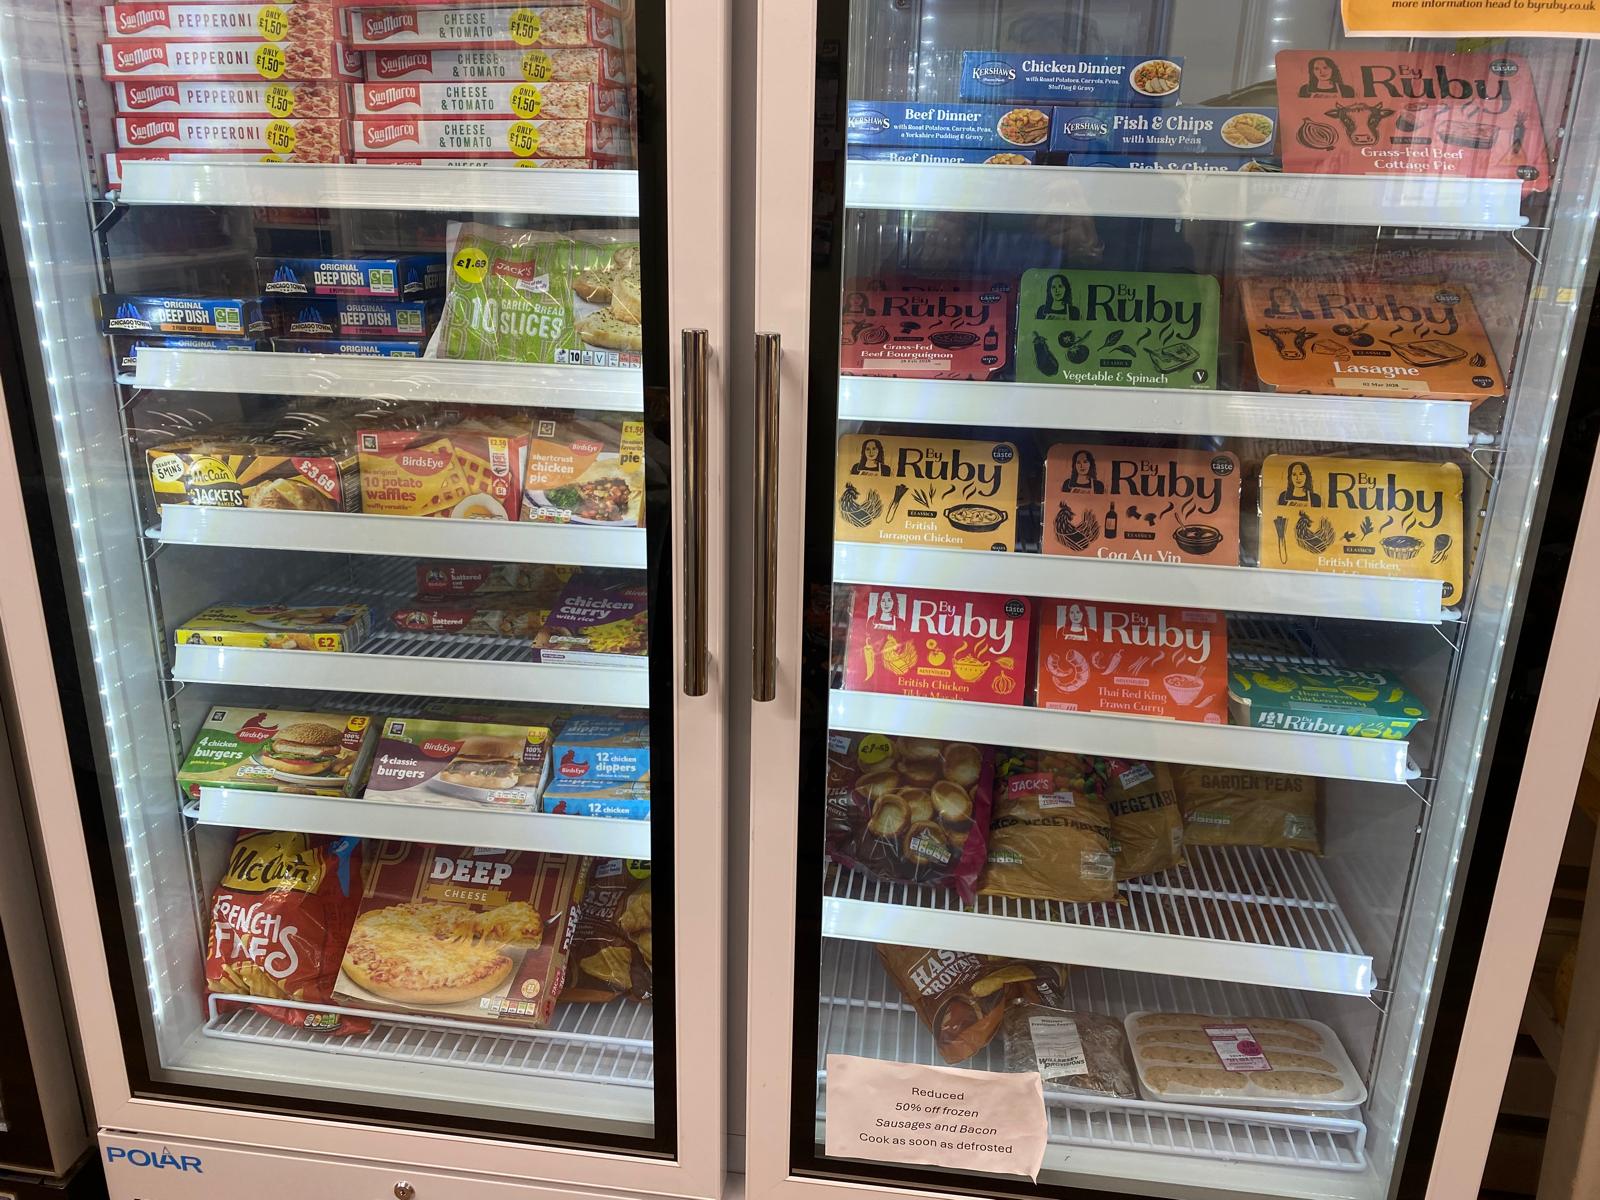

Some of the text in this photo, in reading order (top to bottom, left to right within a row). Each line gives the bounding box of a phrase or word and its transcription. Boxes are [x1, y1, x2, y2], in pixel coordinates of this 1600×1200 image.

[1392, 0, 1596, 12] more information head to byruby.co.uk
[178, 14, 252, 28] PEPPERONI
[266, 10, 282, 19] ONLY
[444, 14, 486, 25] CHEESE
[259, 19, 282, 36] £1.50
[439, 25, 493, 38] & TOMATO
[176, 51, 250, 65] PEPPERONI
[263, 48, 279, 57] ONLY
[457, 53, 499, 64] CHEESE
[256, 56, 279, 73] £1.50
[452, 65, 506, 77] & TOMATO
[1022, 60, 1126, 75] Chicken Dinner
[1398, 64, 1423, 79] By
[446, 86, 487, 98] CHEESE
[1048, 84, 1072, 93] Stuffing
[1077, 84, 1096, 93] Gravy
[1360, 65, 1512, 115] Ruby
[187, 90, 259, 104] PEPPERONI
[905, 108, 982, 122] Beef Dinner
[1113, 114, 1213, 133] Fish & Chips
[935, 132, 960, 142] Pudding
[965, 133, 984, 142] Gravy
[1122, 135, 1201, 147] with Mushy Peas
[1360, 147, 1464, 160] Grass-Fed Beef
[1374, 159, 1456, 174] Cottage Pie
[320, 263, 359, 272] ORIGINAL
[496, 262, 532, 277] JACK'S
[314, 271, 365, 286] DEEP DISH
[1117, 283, 1136, 301] By
[163, 301, 203, 311] ORIGINAL
[501, 298, 565, 317] GARLIC BREAD
[911, 295, 928, 306] By
[346, 304, 385, 312] ORIGINAL
[882, 295, 990, 326] Ruby
[1086, 284, 1202, 341] Ruby
[1316, 294, 1459, 336] Ruby
[159, 308, 210, 324] DEEP DISH
[340, 312, 392, 326] DEEP DISH
[472, 296, 497, 335] 10
[500, 312, 563, 340] SLICES
[883, 343, 933, 351] Grass-Fed
[570, 352, 580, 363] 10
[861, 350, 954, 360] Beef Bourguignon
[1196, 371, 1205, 381] V
[1334, 361, 1420, 380] Lasagne
[1062, 370, 1169, 387] Vegetable & Spinach
[572, 443, 598, 455] BirdsEye
[925, 448, 943, 464] By
[993, 450, 1013, 460] taste
[402, 455, 444, 470] BirdsEye
[533, 453, 574, 463] shortcrust
[620, 452, 640, 466] pie
[298, 459, 335, 491] £3.69
[531, 463, 574, 475] chicken
[896, 447, 1003, 497] Ruby
[1140, 459, 1159, 477] By
[193, 469, 230, 483] McCain
[529, 474, 548, 487] pie
[364, 477, 424, 490] 10 potato
[1110, 460, 1222, 515] Ruby
[194, 488, 243, 506] JACKETS
[366, 487, 417, 502] waffles
[905, 520, 938, 532] British
[879, 530, 964, 545] Tarragon Chicken
[451, 573, 482, 581] battered
[564, 596, 634, 611] chicken
[556, 614, 595, 623] with rice
[559, 604, 612, 619] curry
[432, 617, 464, 625] battered
[318, 637, 335, 649] £2
[898, 677, 970, 693] British Chicken
[1098, 686, 1168, 705] Thai Red King
[1099, 699, 1165, 716] Prawn Curry
[351, 717, 366, 726] £3
[199, 736, 238, 749] 4 chicken
[193, 747, 244, 763] burgers
[526, 746, 543, 754] 100%
[596, 751, 637, 763] 12 chicken
[380, 754, 418, 767] 4 classic
[376, 765, 425, 782] burgers
[596, 762, 637, 774] dippers
[1011, 779, 1049, 793] JACK'S
[1201, 774, 1303, 793] GARDEN PEAS
[588, 802, 630, 815] 12 chicken
[230, 846, 310, 884] McCain
[430, 856, 513, 886] DEEP
[213, 894, 282, 943] FRENCH
[911, 1087, 965, 1101] Reduced
[895, 1102, 980, 1119] 50% off frozen
[875, 1118, 997, 1137] Sausages and Bacon
[859, 1132, 1013, 1155] Cook as soon as defrosted
[106, 1145, 204, 1174] POLAR
